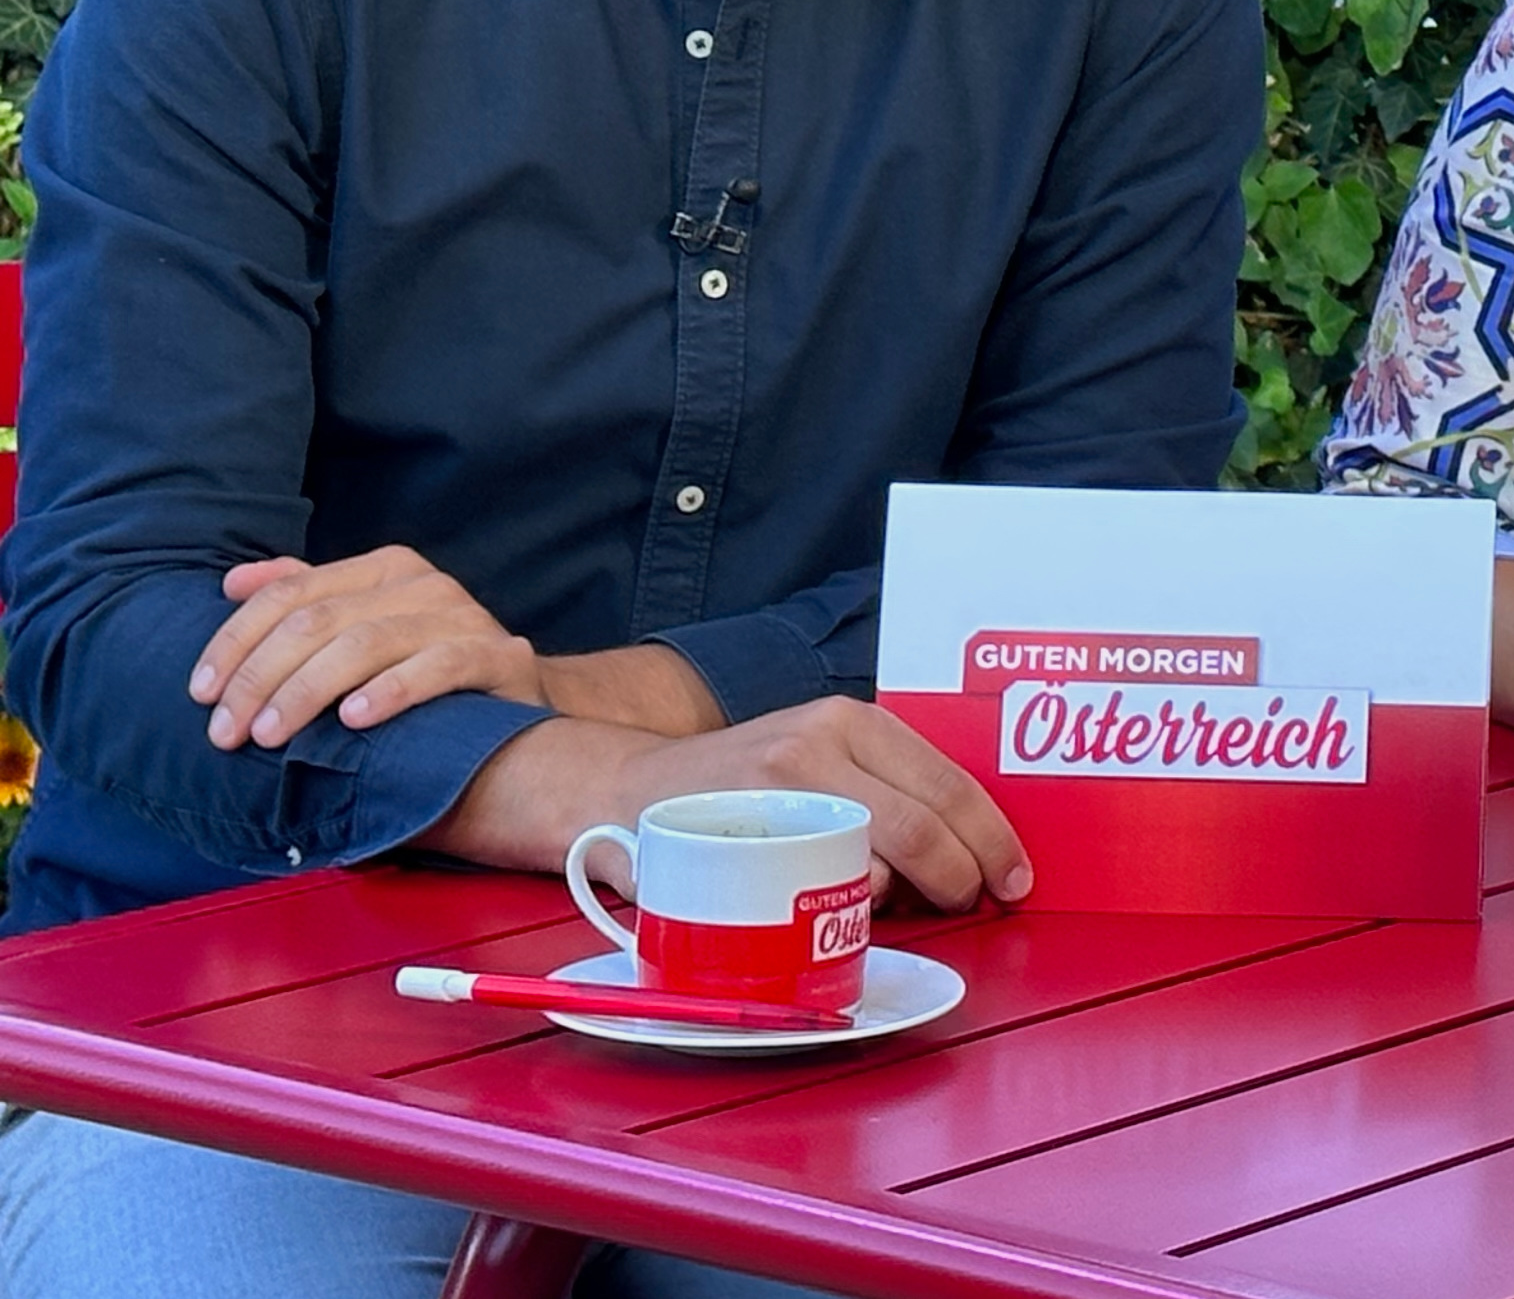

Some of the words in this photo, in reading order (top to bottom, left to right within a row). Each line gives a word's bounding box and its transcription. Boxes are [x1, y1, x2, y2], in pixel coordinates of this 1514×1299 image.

[975, 644, 1088, 670] GUTEN
[1100, 647, 1245, 675] MORGEN
[1013, 681, 1355, 769] Österreich
[798, 891, 848, 911] GUTEN
